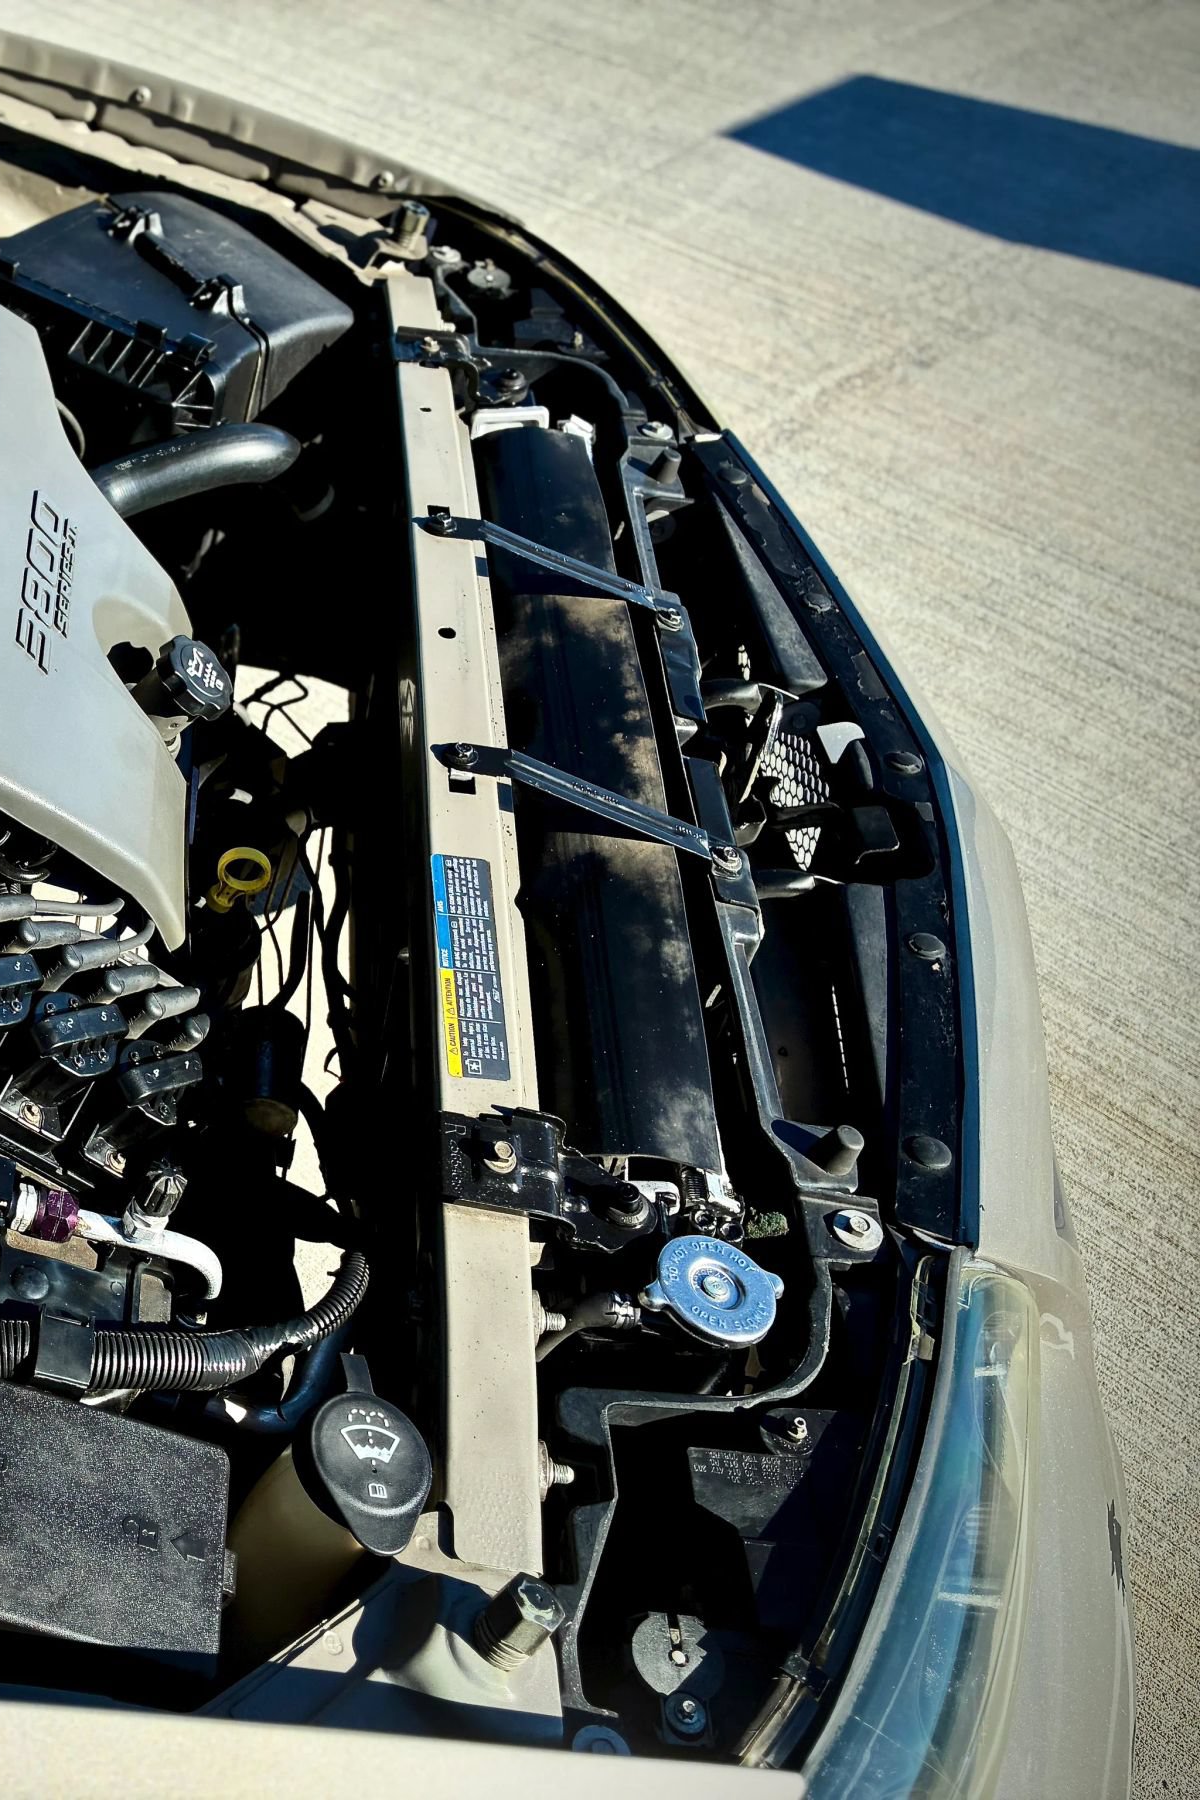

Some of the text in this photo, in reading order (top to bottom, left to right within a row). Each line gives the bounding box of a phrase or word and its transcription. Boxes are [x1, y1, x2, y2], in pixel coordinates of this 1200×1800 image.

[15, 489, 62, 676] 3800
[691, 1241, 726, 1257] OPEN
[729, 1250, 757, 1273] HOT
[690, 1305, 728, 1330] OPEN
